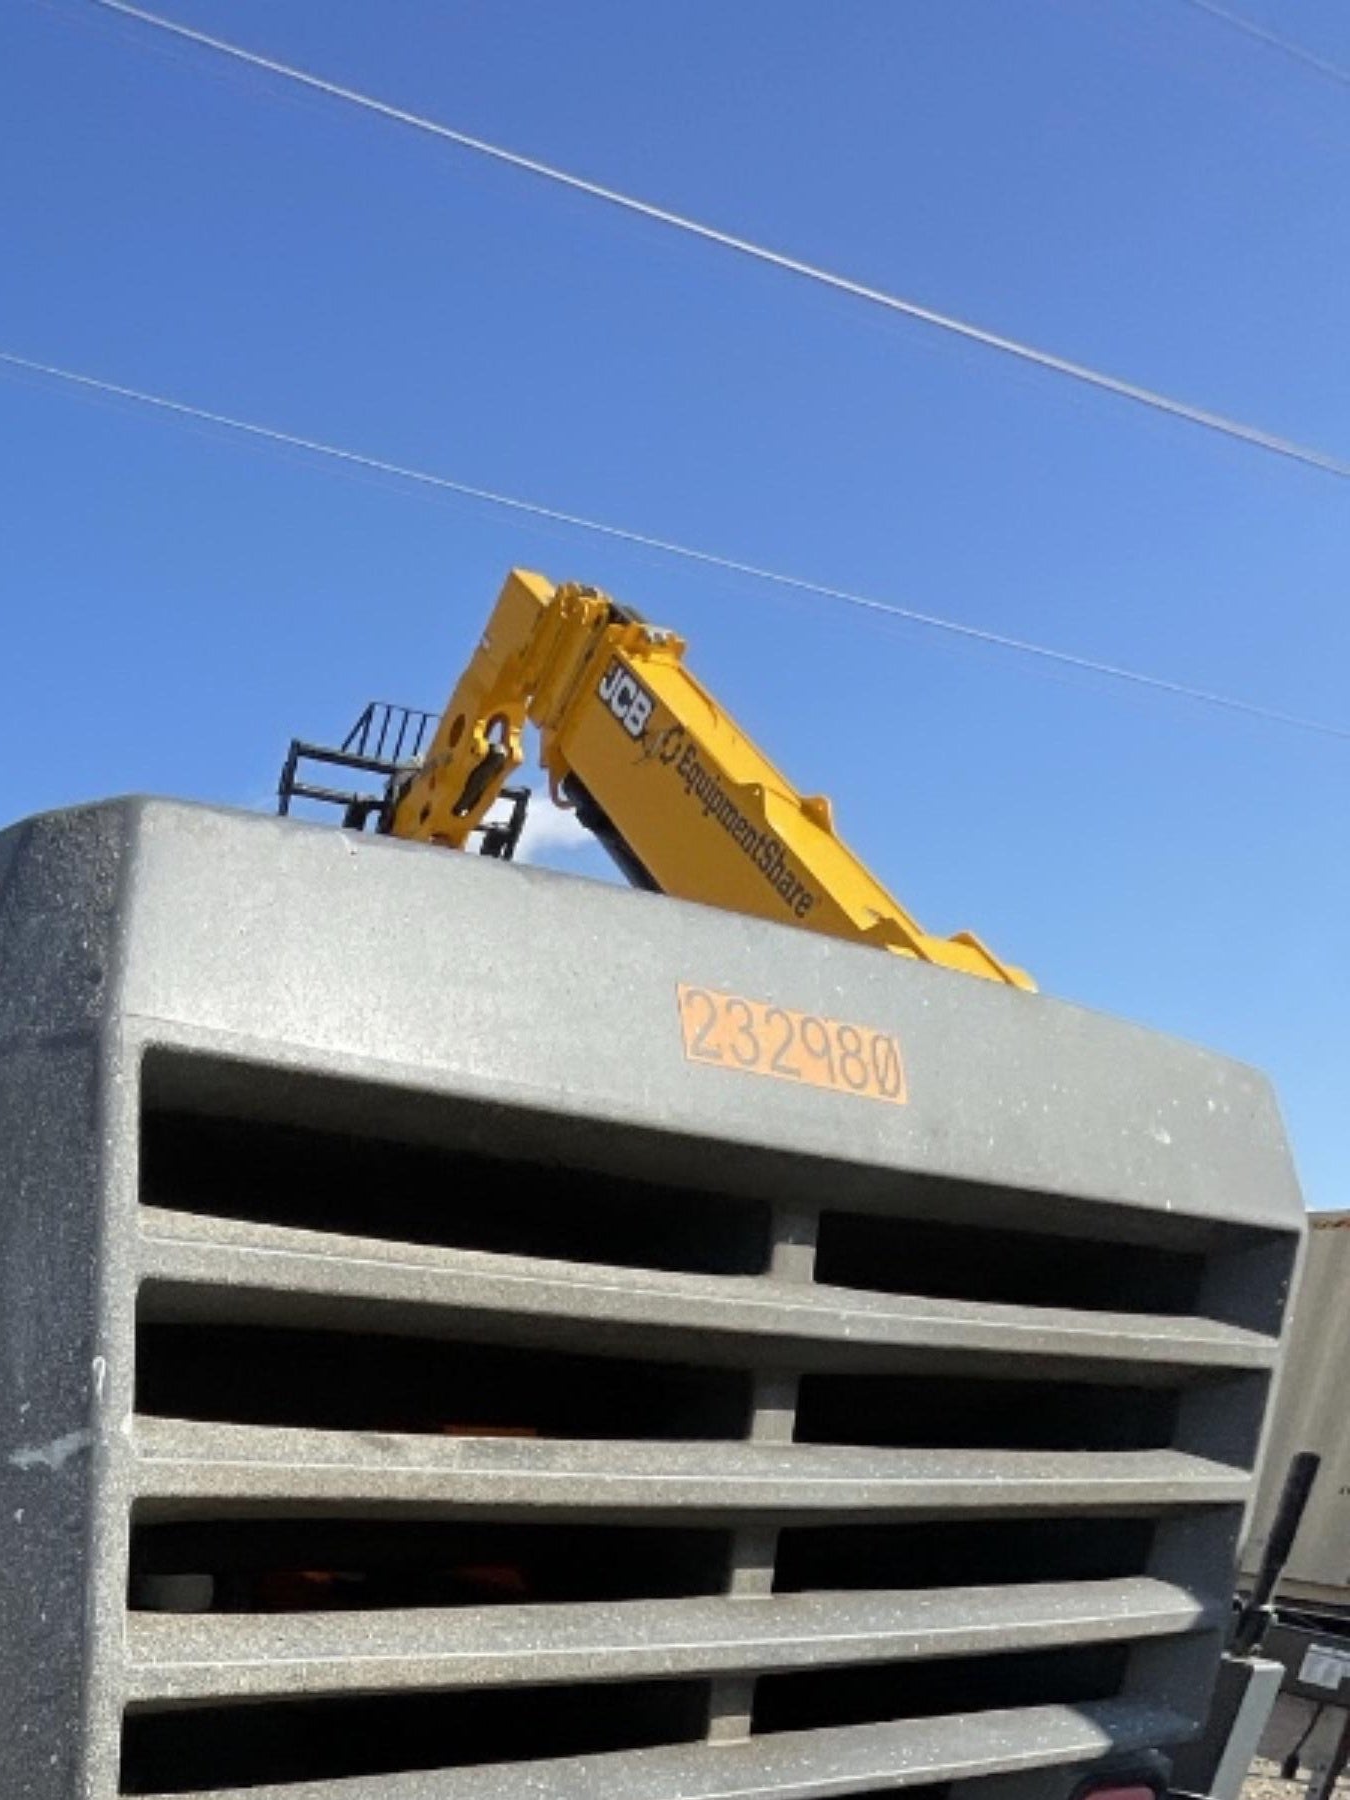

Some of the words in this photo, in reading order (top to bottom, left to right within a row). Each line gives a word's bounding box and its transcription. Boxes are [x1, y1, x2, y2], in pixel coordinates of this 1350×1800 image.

[598, 666, 652, 737] JCB
[678, 749, 814, 918] EquipmentShare
[685, 989, 900, 1098] 232980
